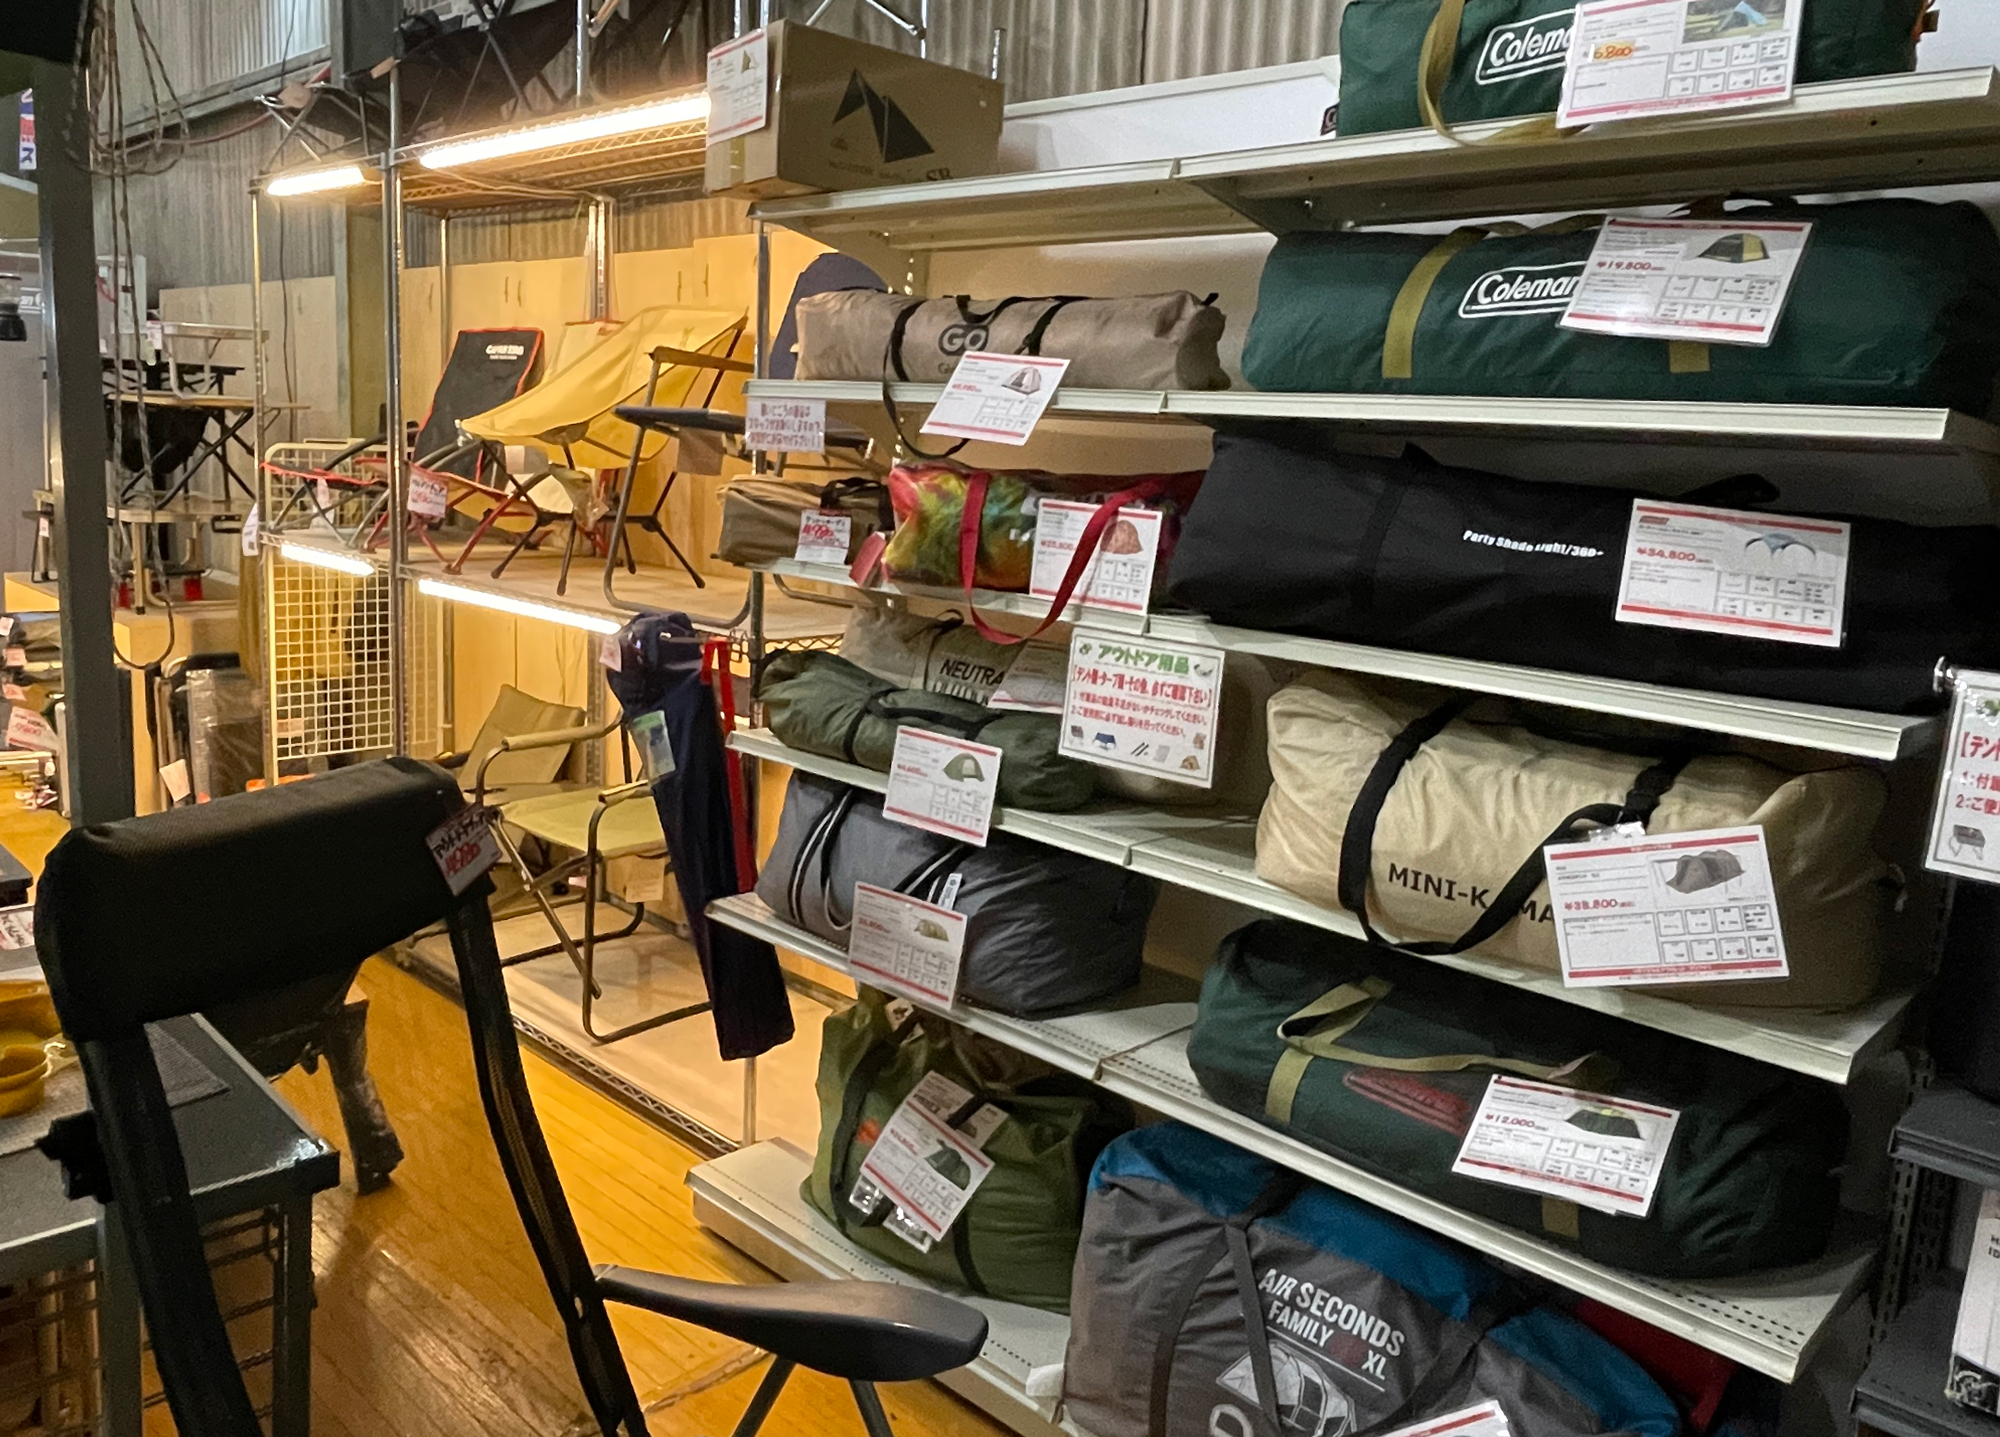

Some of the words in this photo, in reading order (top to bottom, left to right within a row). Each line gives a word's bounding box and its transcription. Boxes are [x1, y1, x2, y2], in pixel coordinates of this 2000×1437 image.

[1097, 644, 1190, 675] アウトドア用品
[1387, 861, 1555, 925] MINI-KMA
[1259, 1268, 1298, 1299] AIR
[1296, 1281, 1407, 1358] SECONDS
[1268, 1299, 1334, 1349] FAMILY
[1361, 1349, 1388, 1381] XL
